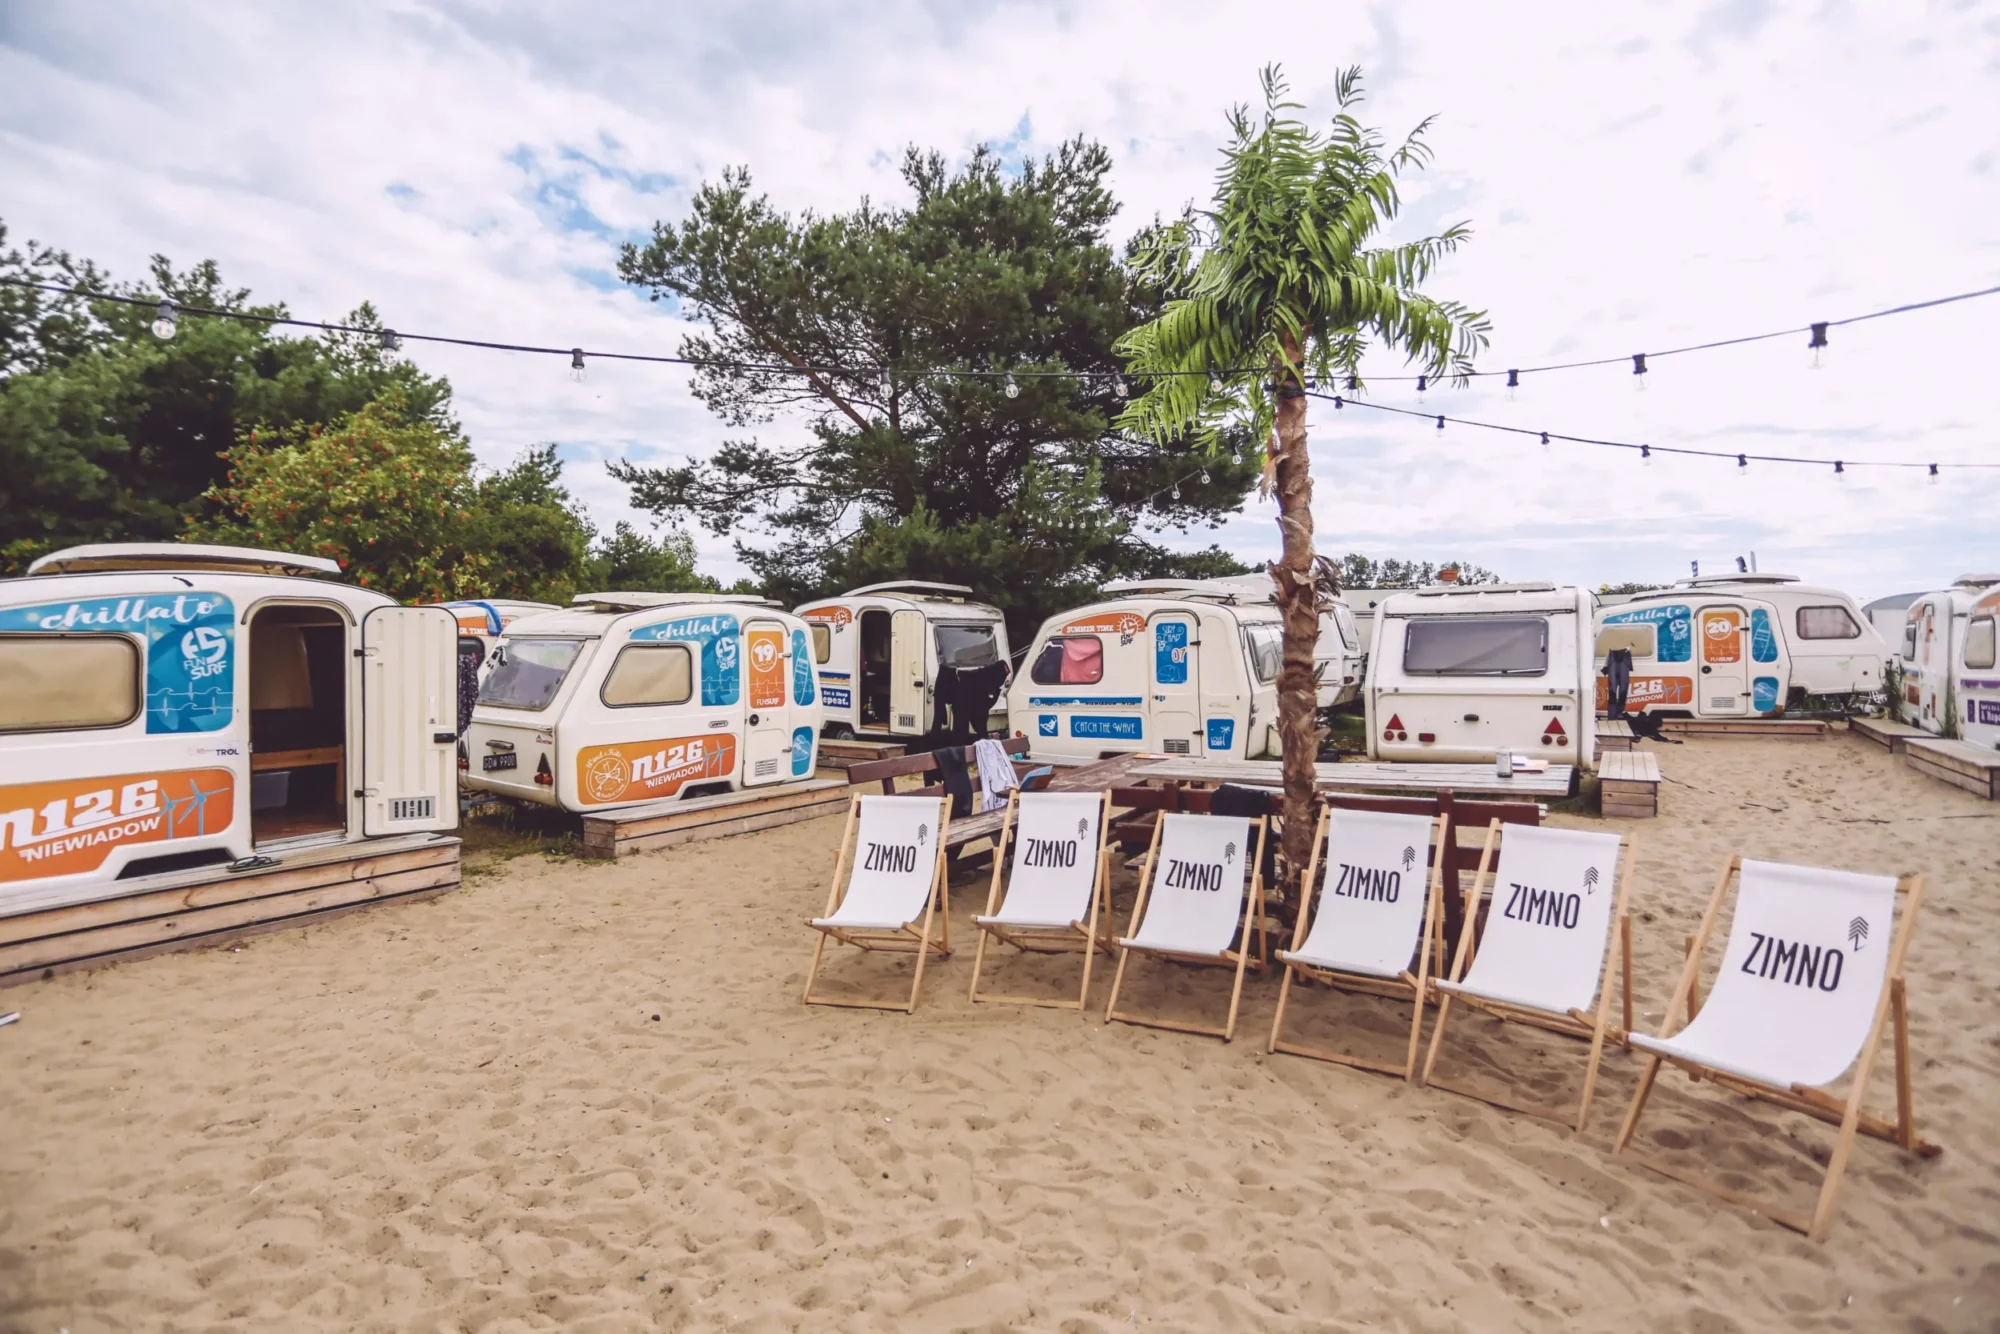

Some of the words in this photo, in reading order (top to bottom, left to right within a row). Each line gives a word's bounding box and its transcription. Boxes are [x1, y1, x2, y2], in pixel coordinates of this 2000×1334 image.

[40, 595, 218, 630] chillato
[656, 617, 732, 640] chillato
[1067, 624, 1096, 633] SUMMER
[1097, 624, 1114, 632] TIME
[1120, 633, 1131, 641] FUN
[1707, 621, 1730, 634] 20
[754, 643, 774, 663] 19
[1120, 638, 1134, 647] SURF
[184, 656, 207, 671] FUN
[720, 658, 736, 672] SURF
[1171, 646, 1187, 663] 07
[190, 659, 228, 681] SURF
[1074, 722, 1097, 733] CATCH
[1099, 722, 1111, 733] THE
[1113, 722, 1136, 734] WAVE
[216, 748, 240, 756] TROL
[645, 763, 703, 788] NIEWIADOW
[18, 816, 161, 863] NIEWIADOW
[865, 843, 916, 872] ZIMNO
[1024, 839, 1076, 867] ZIMNO
[1165, 860, 1222, 891] ZIMNO
[1336, 862, 1401, 903] ZIMNO
[1504, 884, 1580, 929] ZIMNO
[1742, 933, 1843, 991] ZIMNO
